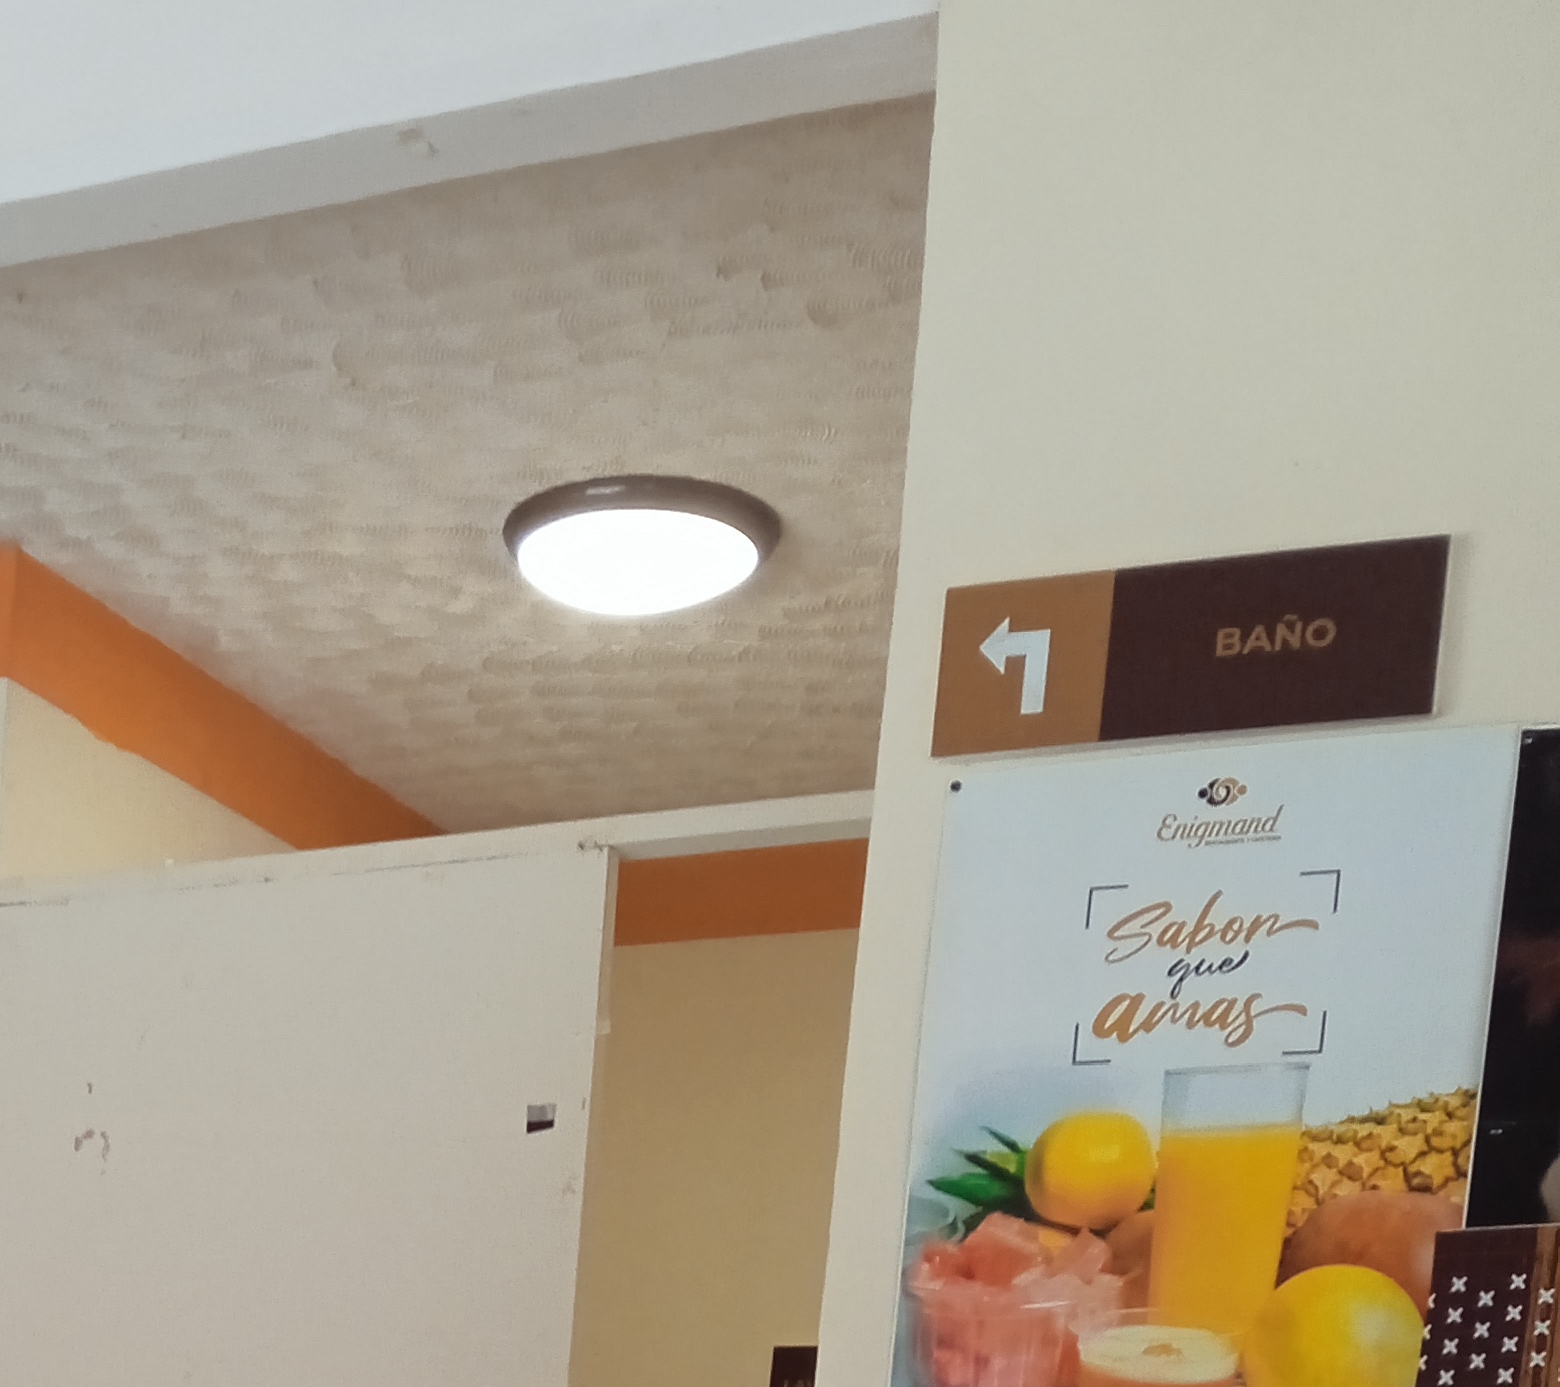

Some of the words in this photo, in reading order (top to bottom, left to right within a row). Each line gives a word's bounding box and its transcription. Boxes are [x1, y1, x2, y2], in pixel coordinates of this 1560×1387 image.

[1214, 613, 1337, 659] BAÑO
[1156, 804, 1285, 849] Enigmand
[1104, 889, 1320, 965] Sabor
[1166, 949, 1250, 1001] que
[1092, 991, 1308, 1048] amas
